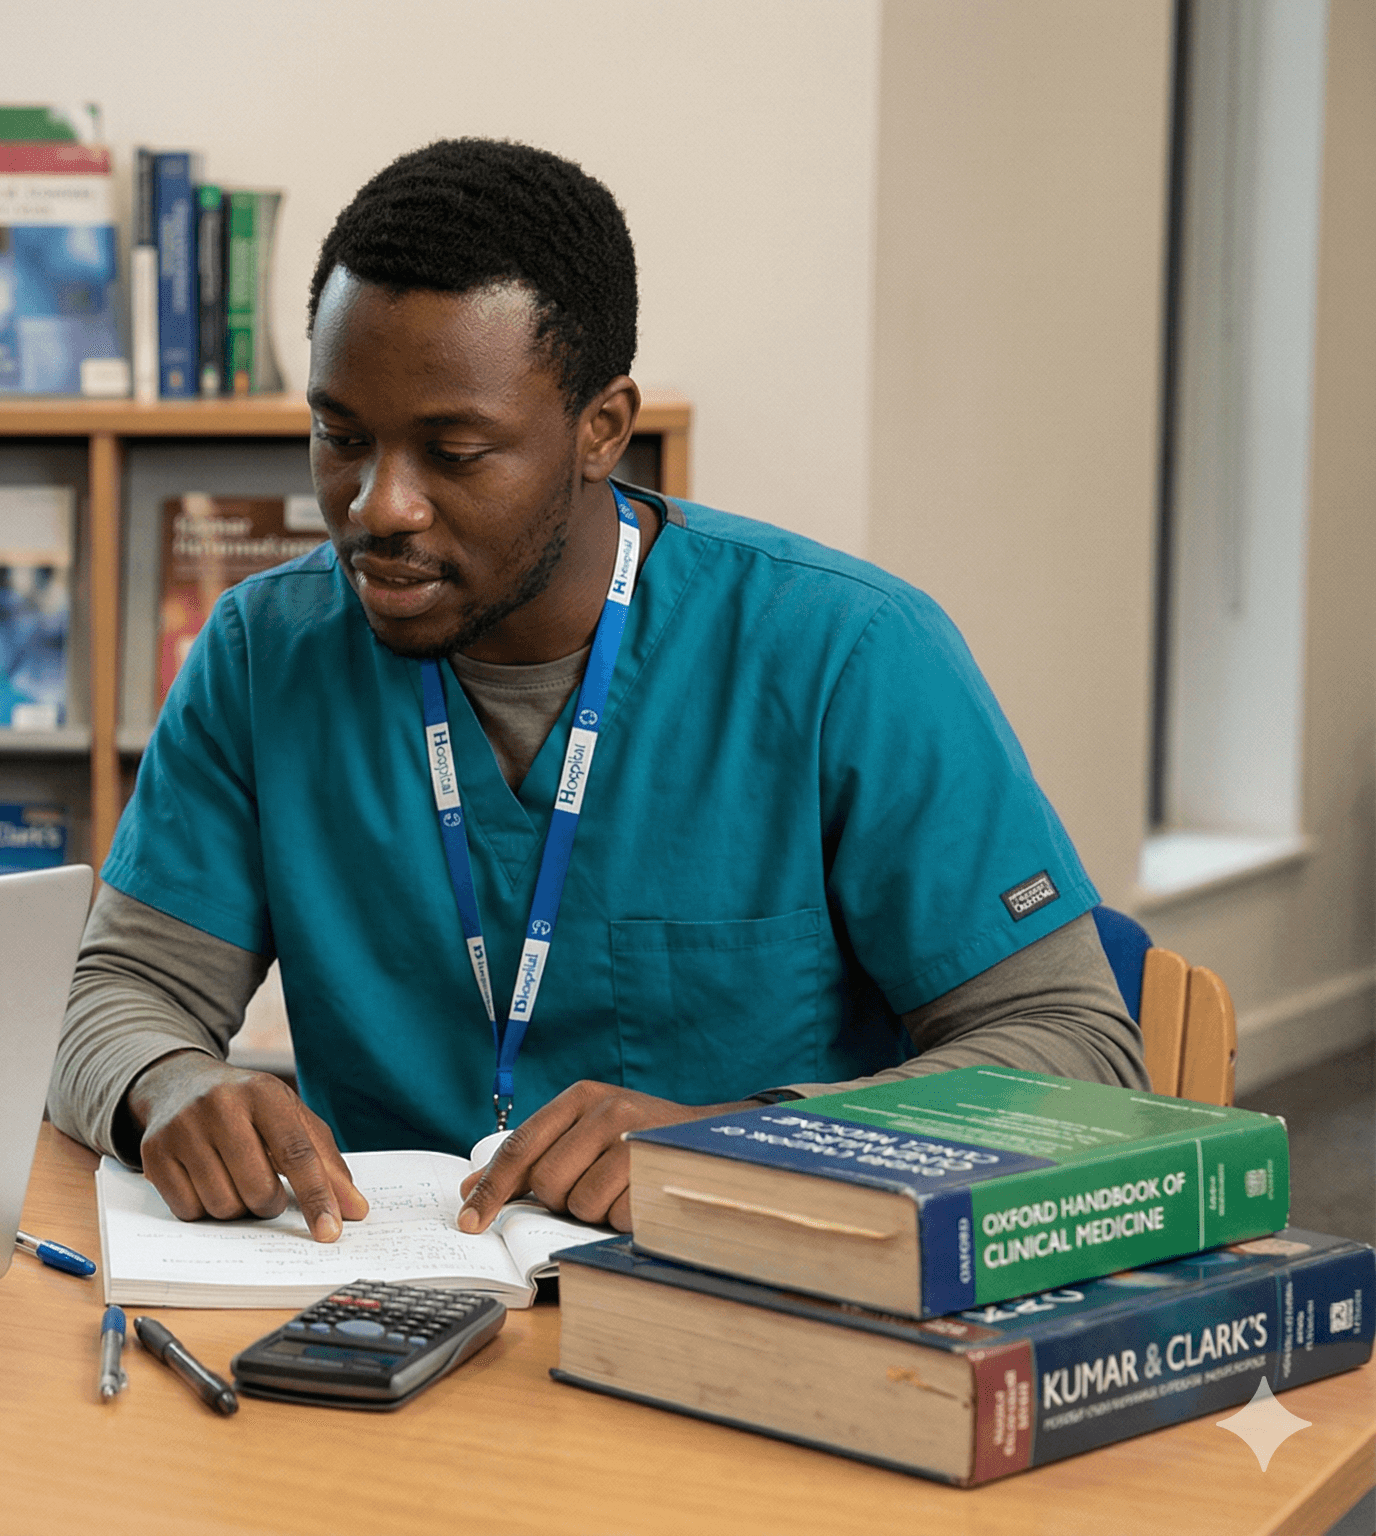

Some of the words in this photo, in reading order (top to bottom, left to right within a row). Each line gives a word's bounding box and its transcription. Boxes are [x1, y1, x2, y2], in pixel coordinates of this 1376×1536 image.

[982, 1200, 1058, 1237] OXFORD
[1060, 1177, 1161, 1219] HANDBOOK
[1162, 1171, 1186, 1196] OF
[983, 1228, 1072, 1269] CLINICAL
[1075, 1206, 1164, 1248] MEDICINE
[1043, 1349, 1139, 1410] KUMAR
[1144, 1343, 1162, 1380] &
[1166, 1312, 1268, 1371] CLARK'S
